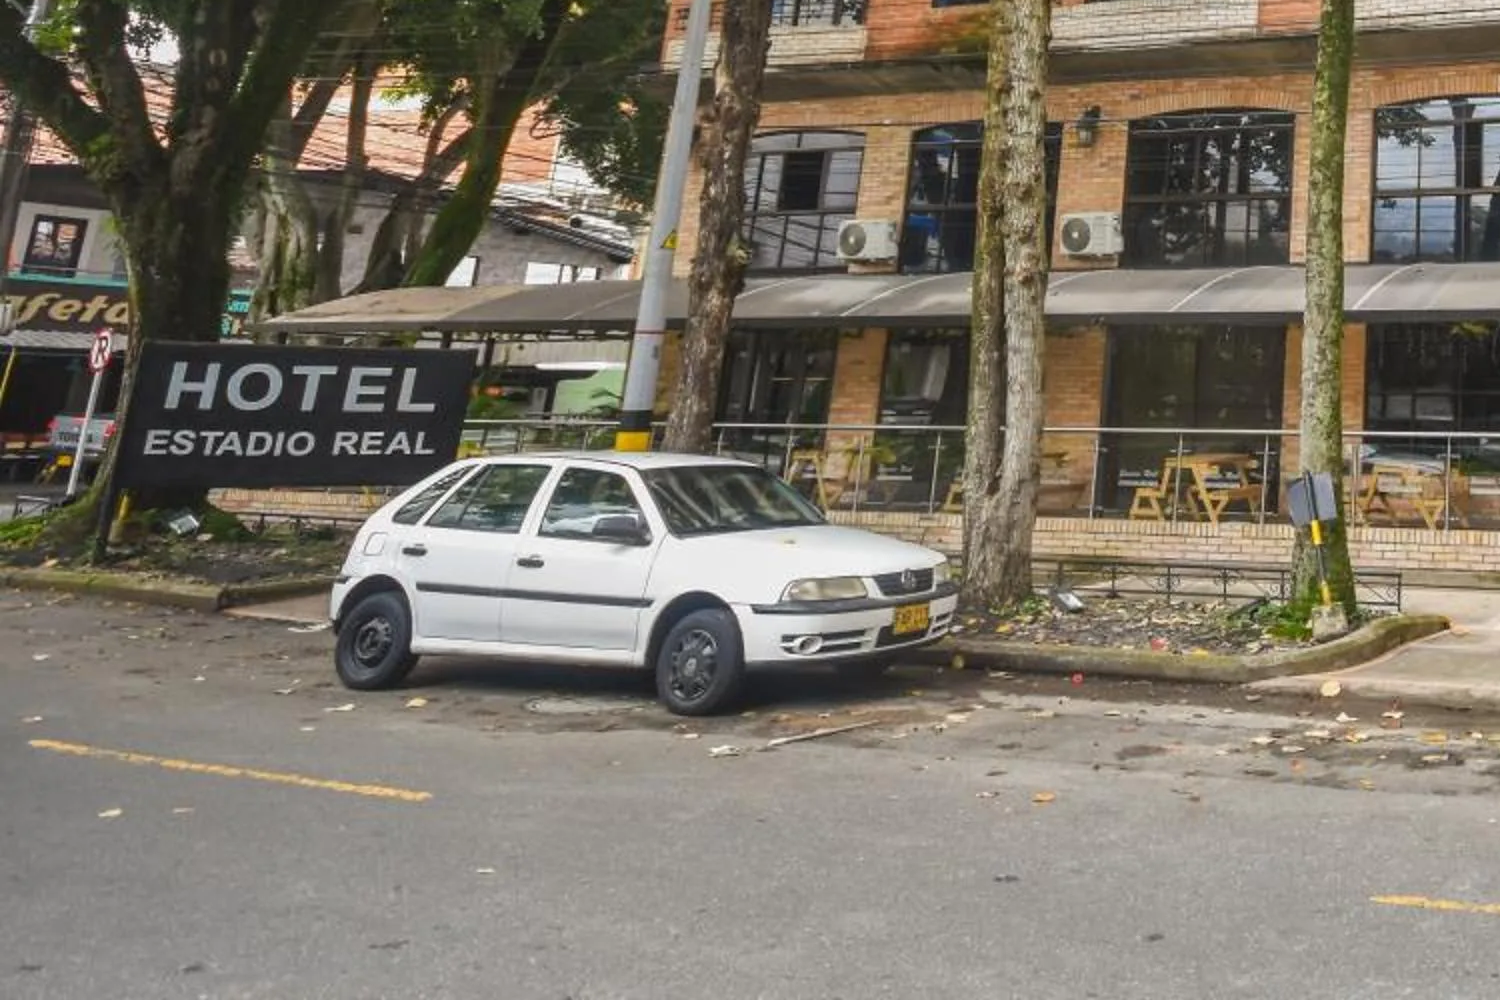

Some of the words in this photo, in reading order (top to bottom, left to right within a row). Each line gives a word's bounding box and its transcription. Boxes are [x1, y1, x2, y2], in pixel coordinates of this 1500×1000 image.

[163, 360, 437, 413] HOTEL
[143, 429, 316, 457] ESTADIO
[331, 431, 437, 456] REAL
